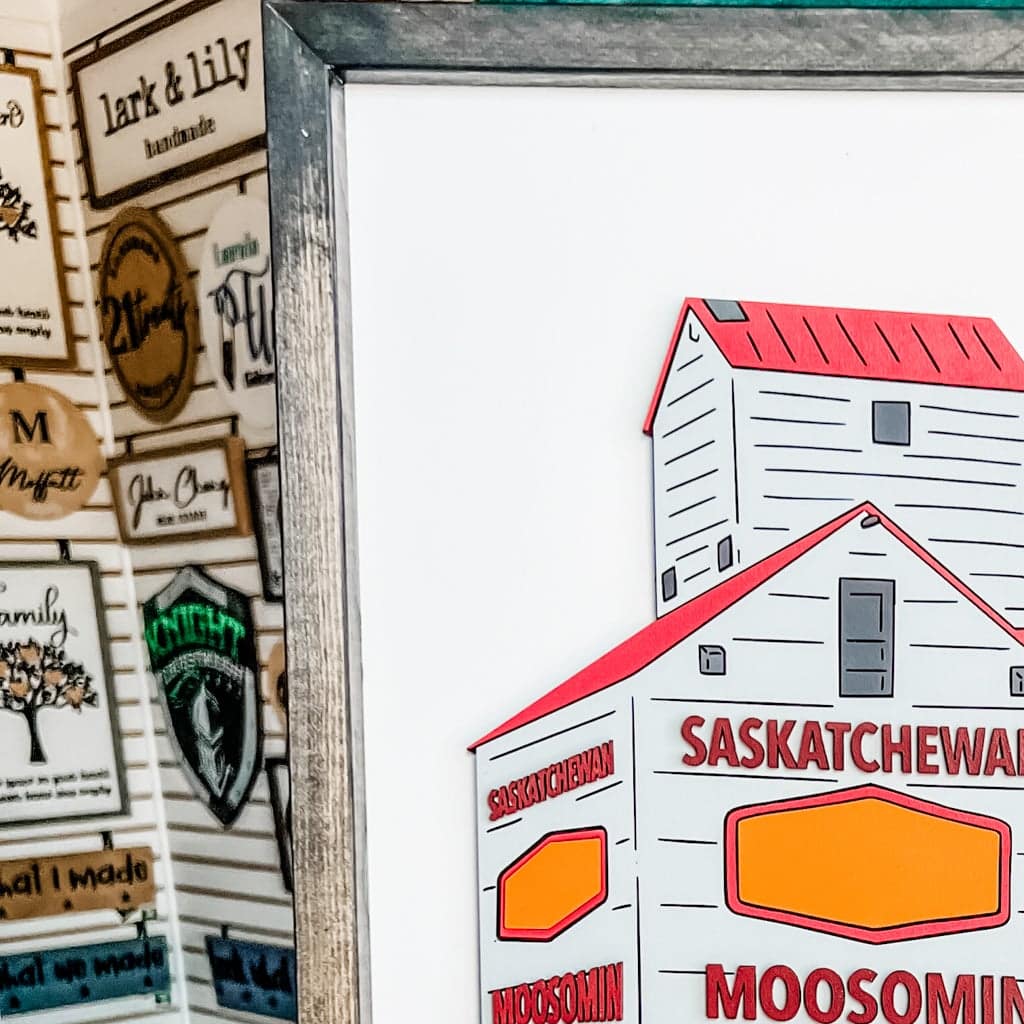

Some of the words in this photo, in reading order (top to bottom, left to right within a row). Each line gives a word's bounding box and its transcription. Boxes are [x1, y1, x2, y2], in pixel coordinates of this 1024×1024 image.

[98, 75, 160, 137] lark
[164, 60, 184, 107] &
[186, 37, 251, 91] lily
[8, 409, 51, 444] M
[0, 584, 68, 648] amily
[488, 739, 615, 821] SASKATCHEWAN
